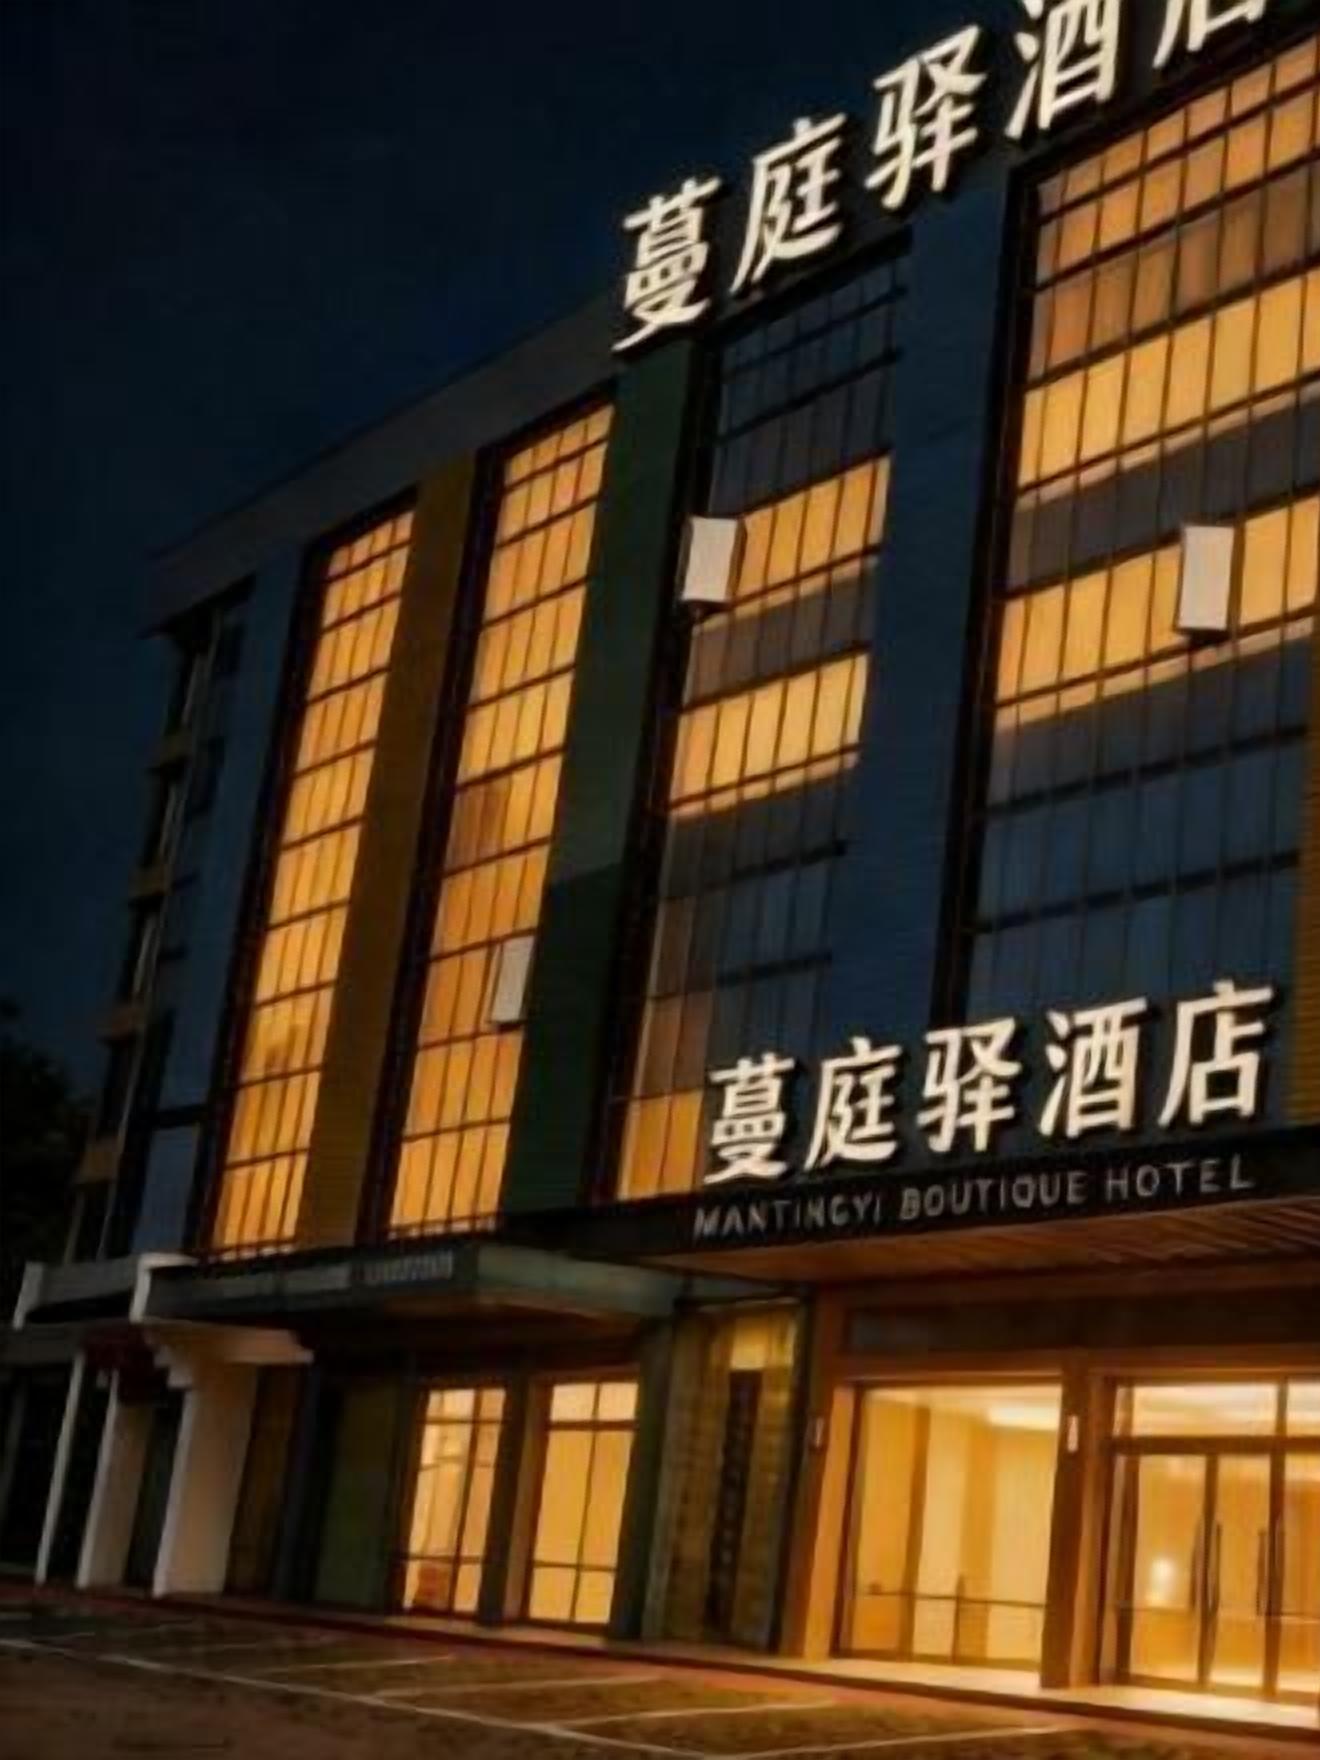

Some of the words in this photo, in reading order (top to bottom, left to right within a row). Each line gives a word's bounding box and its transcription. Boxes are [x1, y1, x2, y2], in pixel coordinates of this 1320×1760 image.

[704, 980, 1272, 1184] 蔓庭驿酒店
[898, 1169, 1090, 1221] BOUTIQUE
[1104, 1152, 1258, 1204] HOTEL
